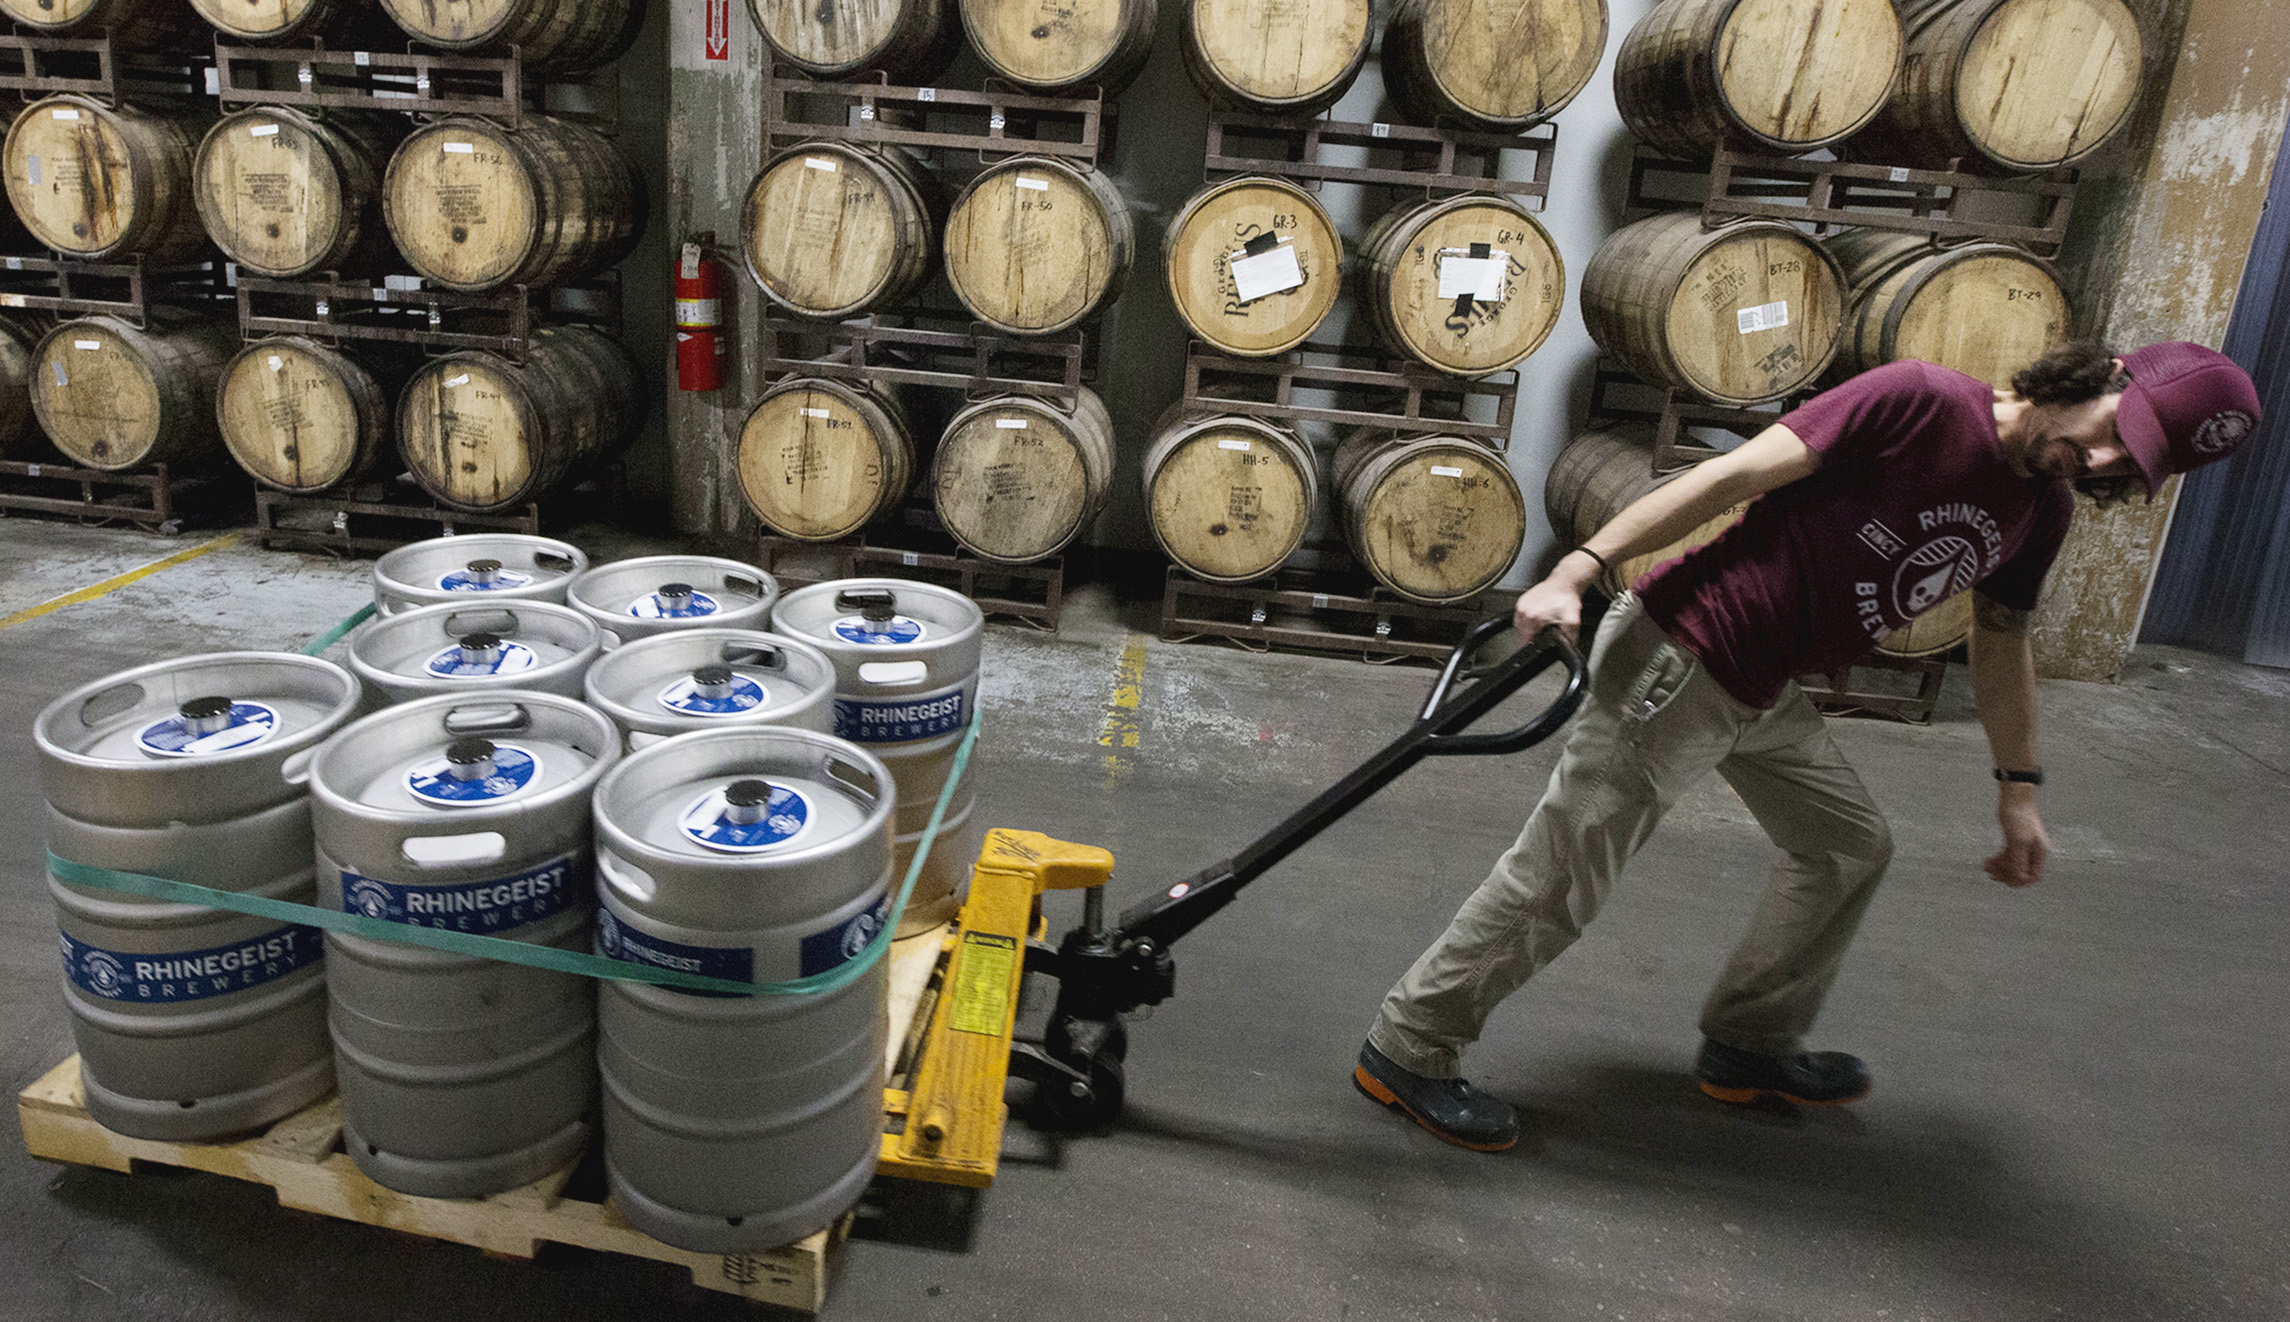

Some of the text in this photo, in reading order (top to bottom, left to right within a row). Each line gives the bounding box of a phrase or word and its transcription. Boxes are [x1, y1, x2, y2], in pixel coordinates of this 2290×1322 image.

[1273, 214, 1297, 229] GR-3
[1498, 229, 1524, 245] GR-4
[1770, 261, 1800, 276] BT-28
[2008, 288, 2042, 301] BT-29
[1243, 454, 1269, 465] HH-5
[1463, 477, 1489, 488] HH-6
[1917, 503, 2001, 575] RHINEGEIS
[861, 695, 961, 723] RHINEGEIST
[861, 714, 958, 737] BREWERY
[406, 867, 565, 914] RHINEGEIST
[135, 931, 298, 982] RHINEGEIST
[138, 953, 298, 997] BREWERY
